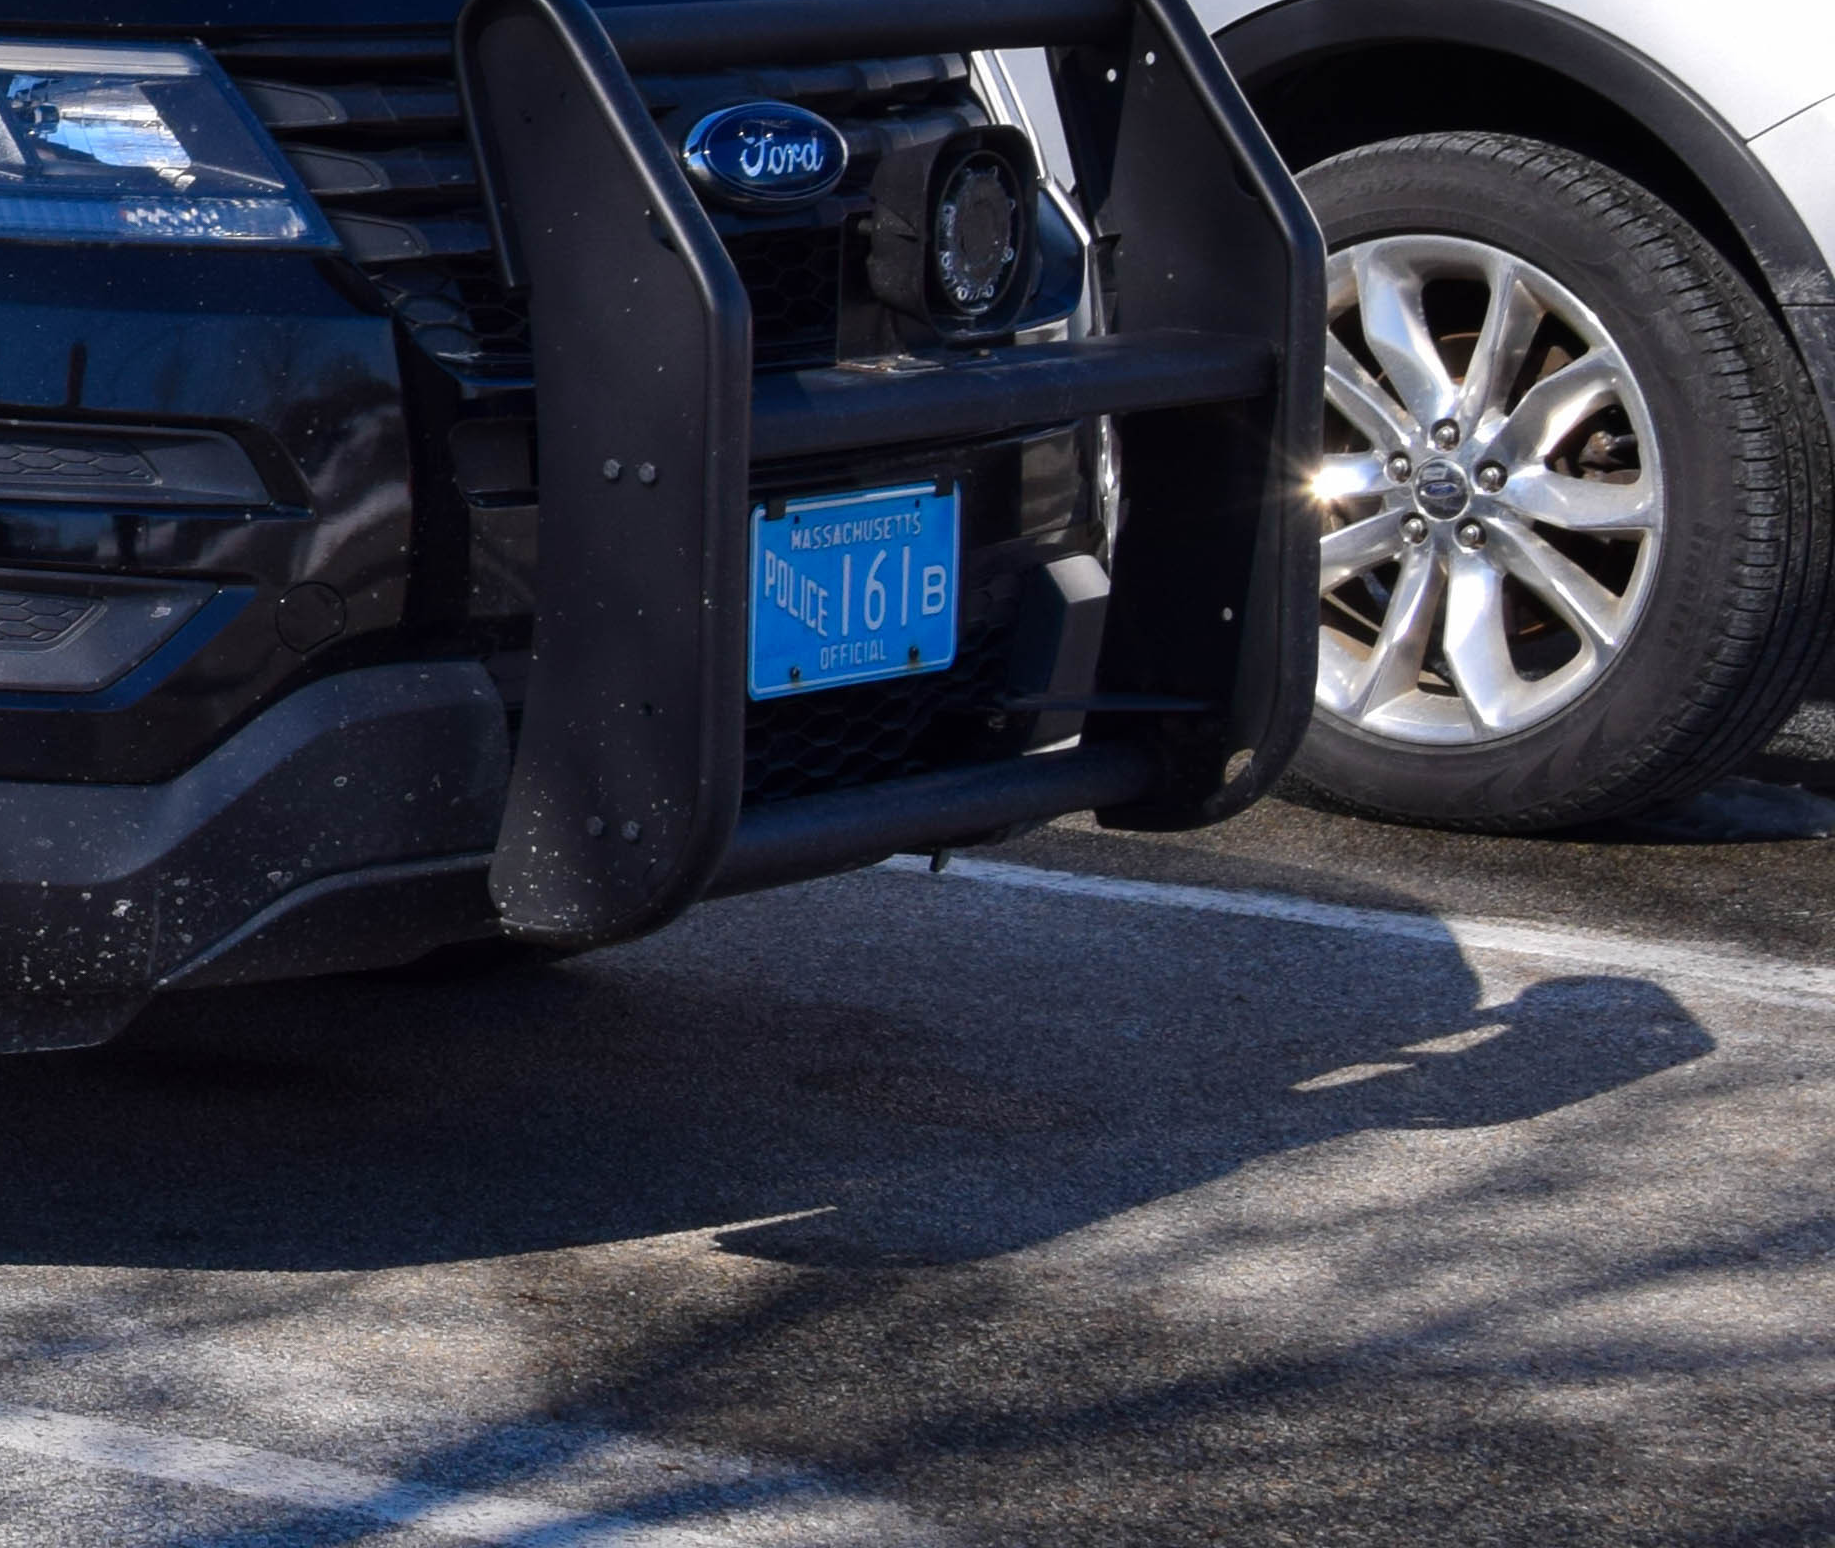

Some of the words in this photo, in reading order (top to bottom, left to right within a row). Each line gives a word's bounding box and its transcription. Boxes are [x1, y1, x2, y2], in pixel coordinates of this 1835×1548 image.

[738, 120, 824, 177] Ford
[791, 511, 922, 550] MASSACHUSETTS
[764, 549, 828, 637] POLICE
[820, 639, 887, 670] OFFICIAL
